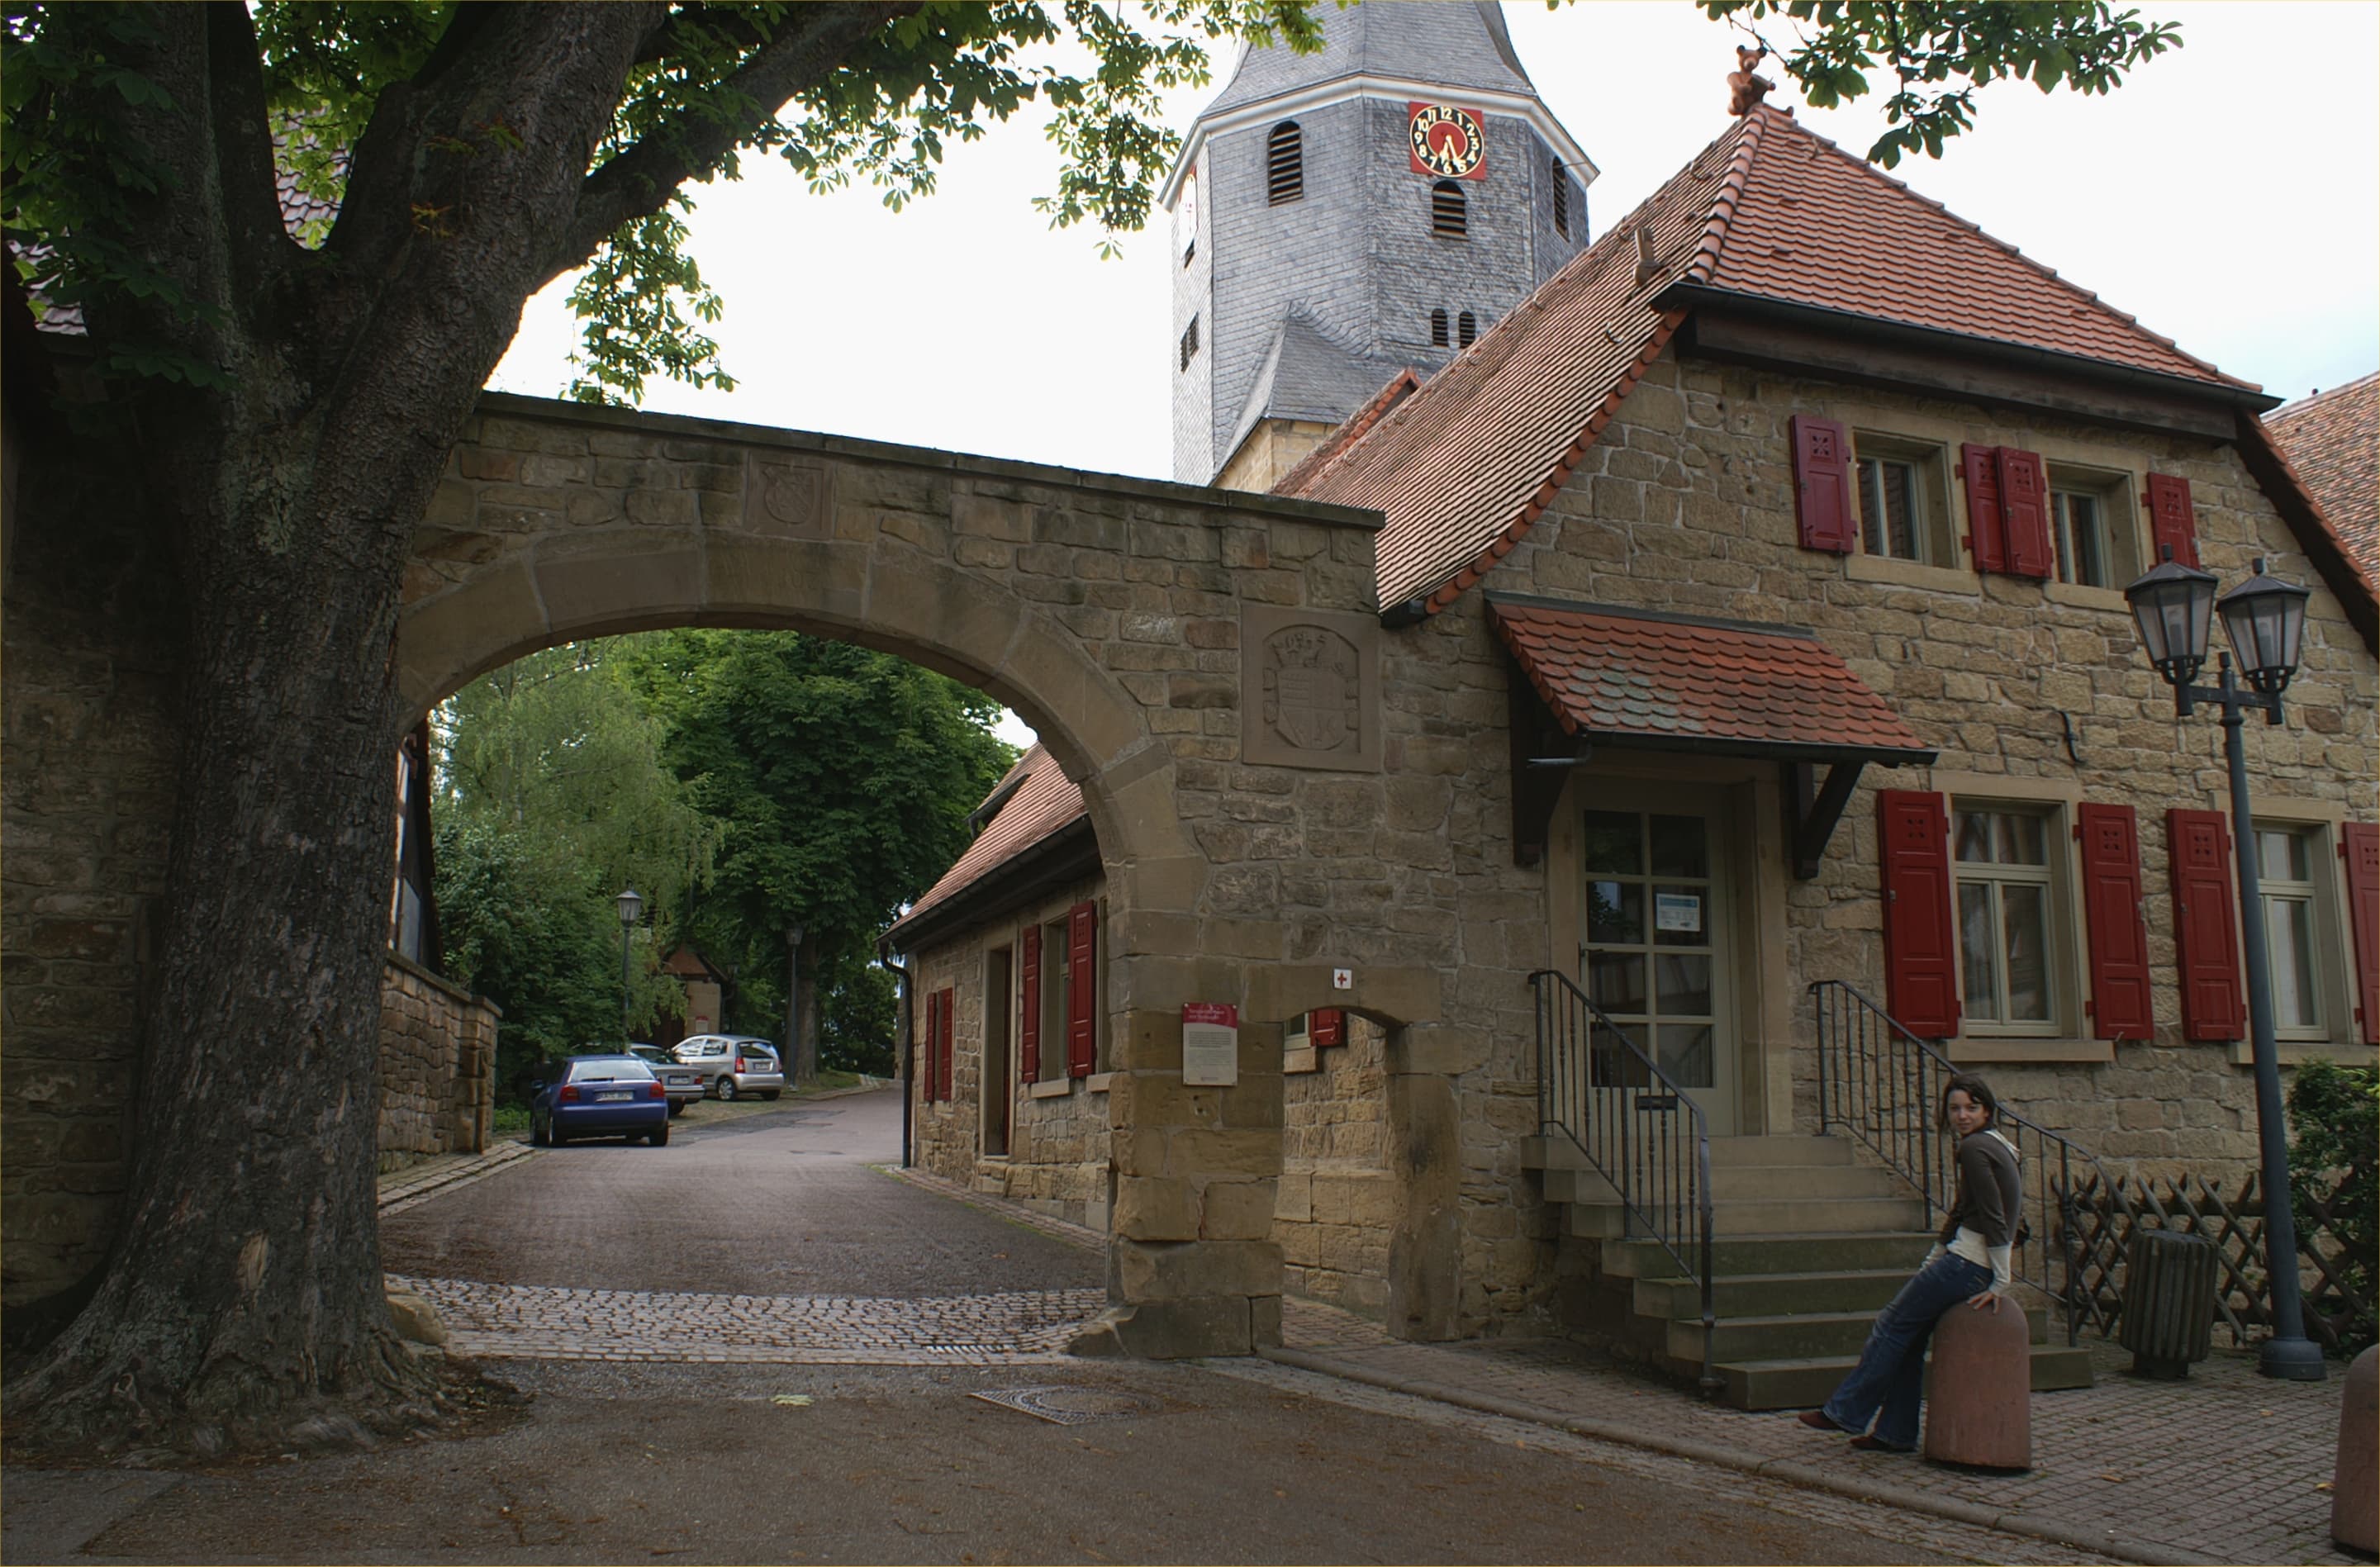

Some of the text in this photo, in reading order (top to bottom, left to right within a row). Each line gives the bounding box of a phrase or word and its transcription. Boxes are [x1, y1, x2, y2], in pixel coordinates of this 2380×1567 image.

[1428, 109, 1437, 122] 11
[1440, 106, 1452, 120] 12
[1456, 113, 1463, 126] 1
[1417, 118, 1428, 132] 10
[1466, 123, 1475, 136] 2
[1413, 131, 1423, 144] 9
[1470, 137, 1480, 150] 3
[1419, 145, 1428, 157] 8
[1466, 150, 1476, 164] 4
[1429, 155, 1437, 169] 7
[1442, 161, 1452, 174] 6
[1458, 159, 1466, 173] 5
